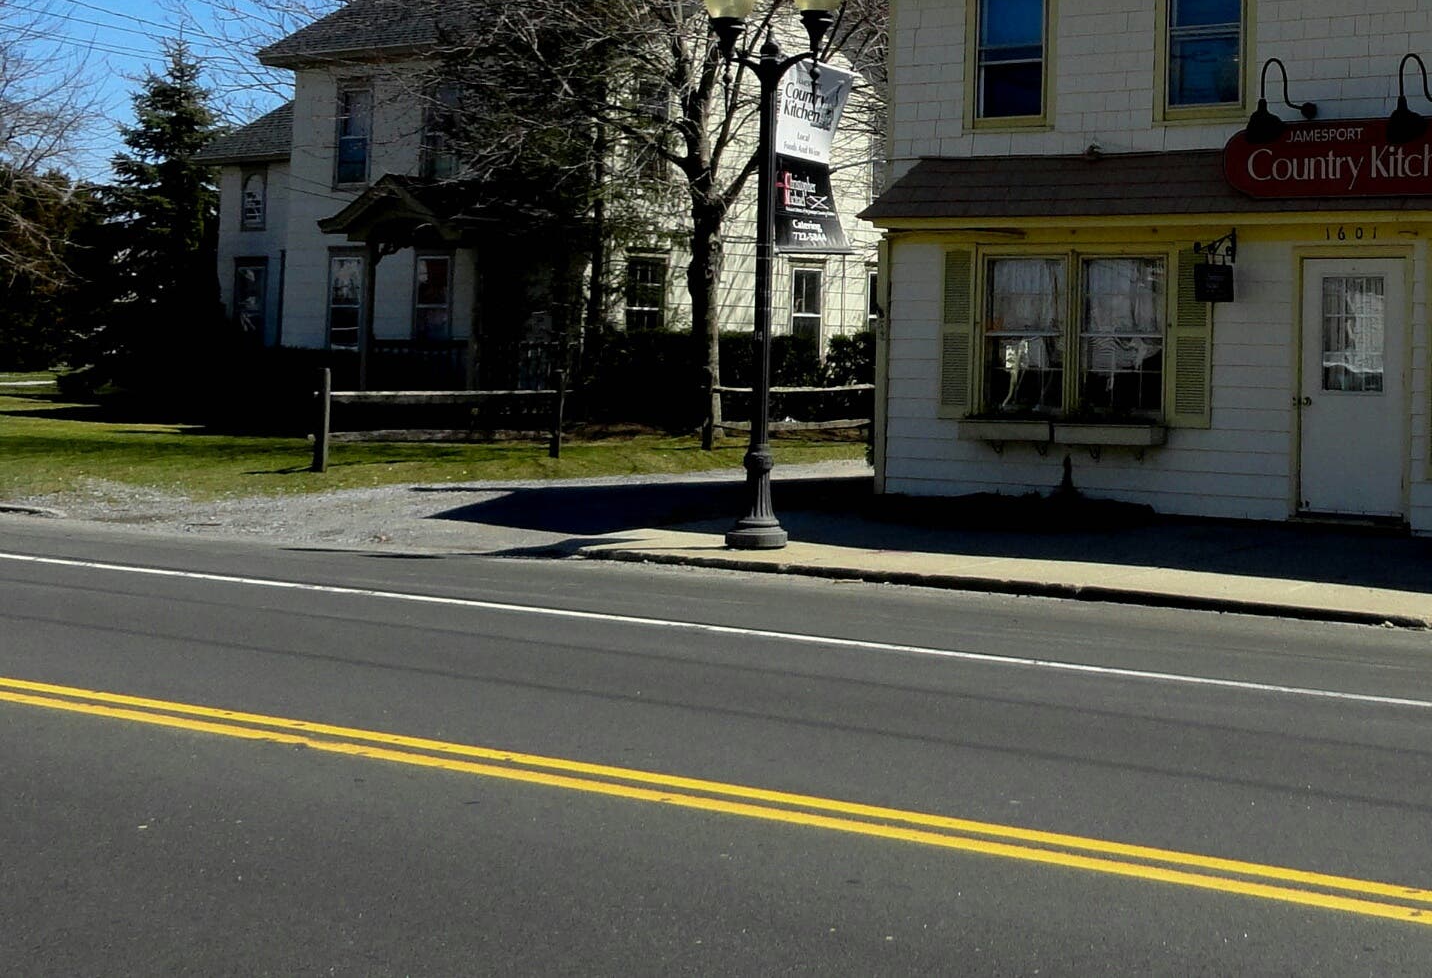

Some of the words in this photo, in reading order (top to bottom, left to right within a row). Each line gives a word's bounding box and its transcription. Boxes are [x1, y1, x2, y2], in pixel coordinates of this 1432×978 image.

[786, 82, 828, 107] Counry
[784, 100, 821, 122] Kitchen
[1286, 127, 1364, 143] JAMESPORT
[1247, 148, 1364, 191] Country
[1325, 226, 1378, 241] 1601
